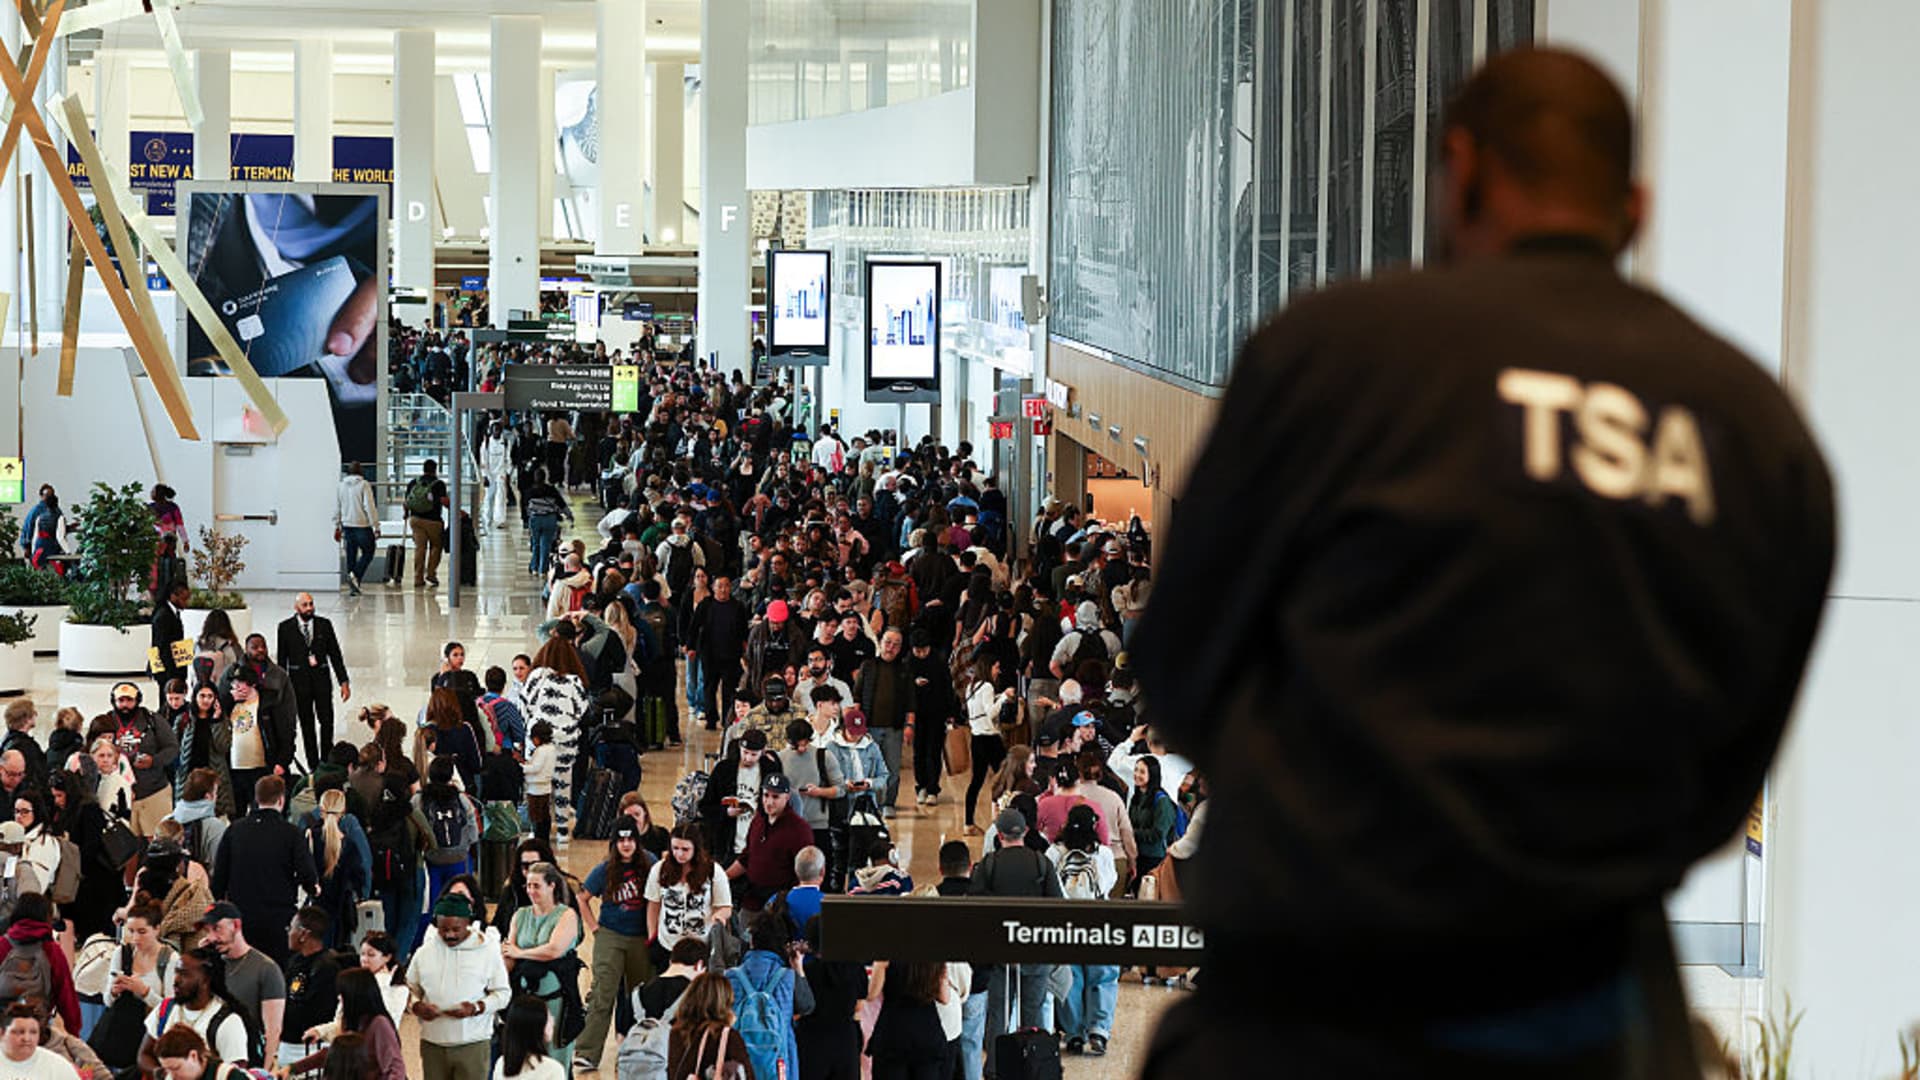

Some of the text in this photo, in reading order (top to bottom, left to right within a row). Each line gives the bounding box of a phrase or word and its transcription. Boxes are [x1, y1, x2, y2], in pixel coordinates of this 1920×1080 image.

[149, 164, 180, 178] NEW
[353, 169, 395, 183] WORLD
[408, 201, 425, 221] D
[615, 204, 630, 228] E
[721, 205, 738, 231] F
[555, 368, 589, 376] Terminals
[530, 399, 610, 409] Ground Transportation
[1496, 366, 1717, 527] TSA
[1002, 920, 1127, 945] Terminals
